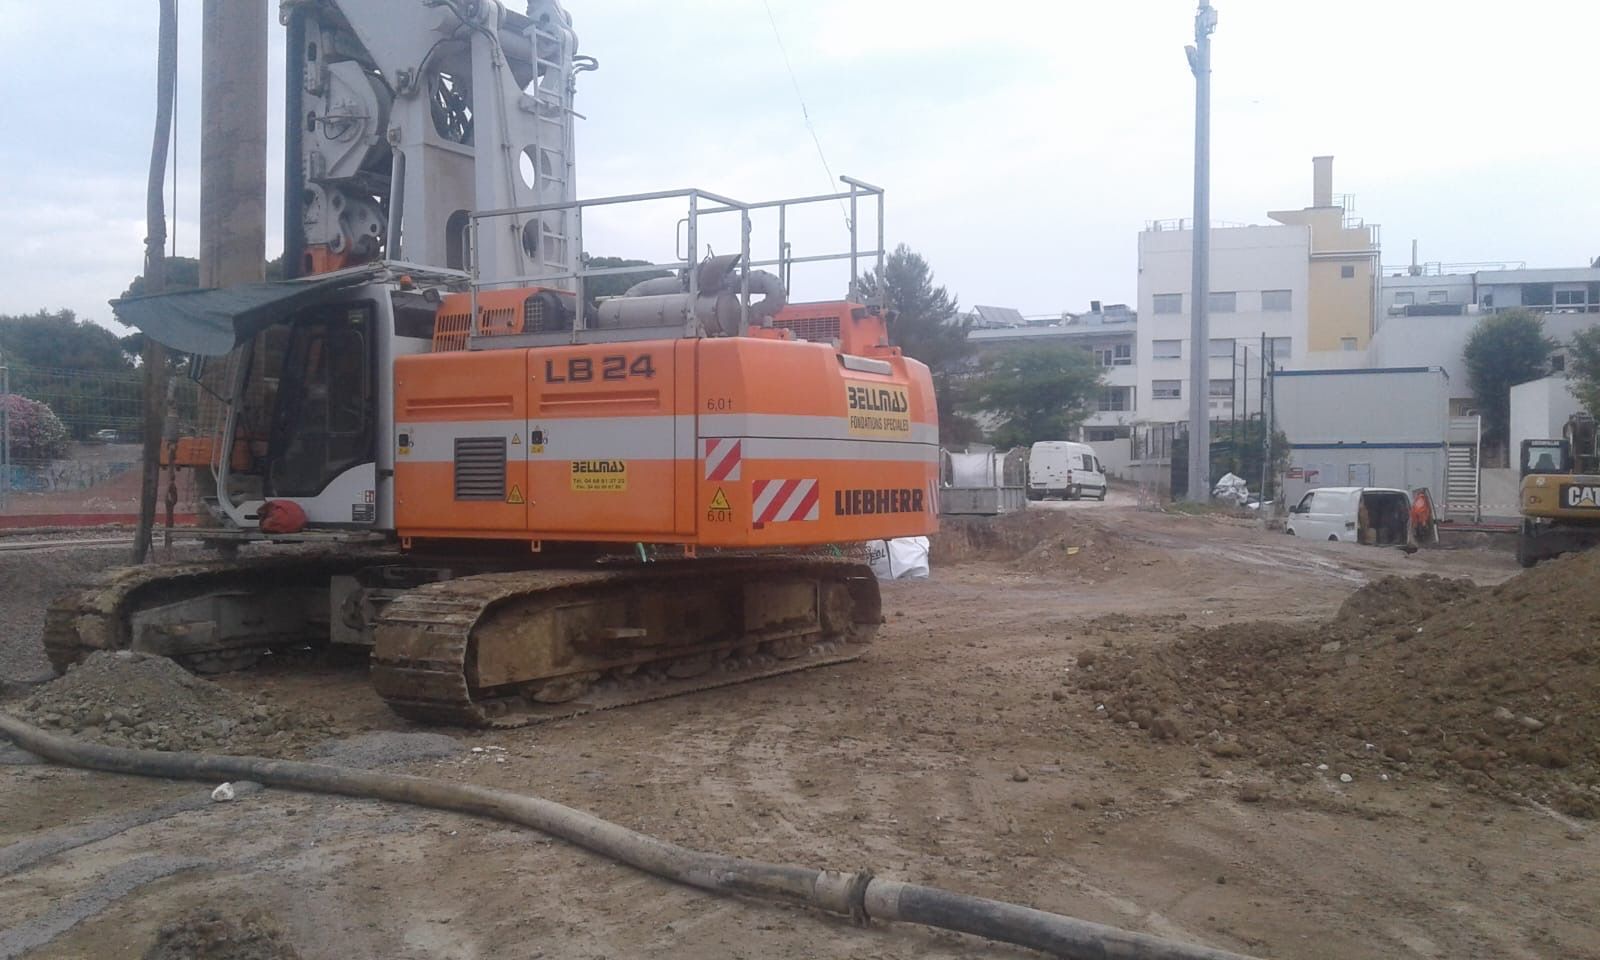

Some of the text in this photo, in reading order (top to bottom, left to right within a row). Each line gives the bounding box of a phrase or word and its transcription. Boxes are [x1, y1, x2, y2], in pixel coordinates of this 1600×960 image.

[545, 354, 656, 383] LB 24
[728, 397, 733, 410] t
[848, 386, 908, 413] BELLMAS
[850, 415, 909, 432] FONDATIONS SPECIALES
[572, 461, 625, 473] BELLMAS
[835, 488, 924, 516] LIEBHERR
[1568, 486, 1600, 507] CAT
[728, 510, 733, 523] t
